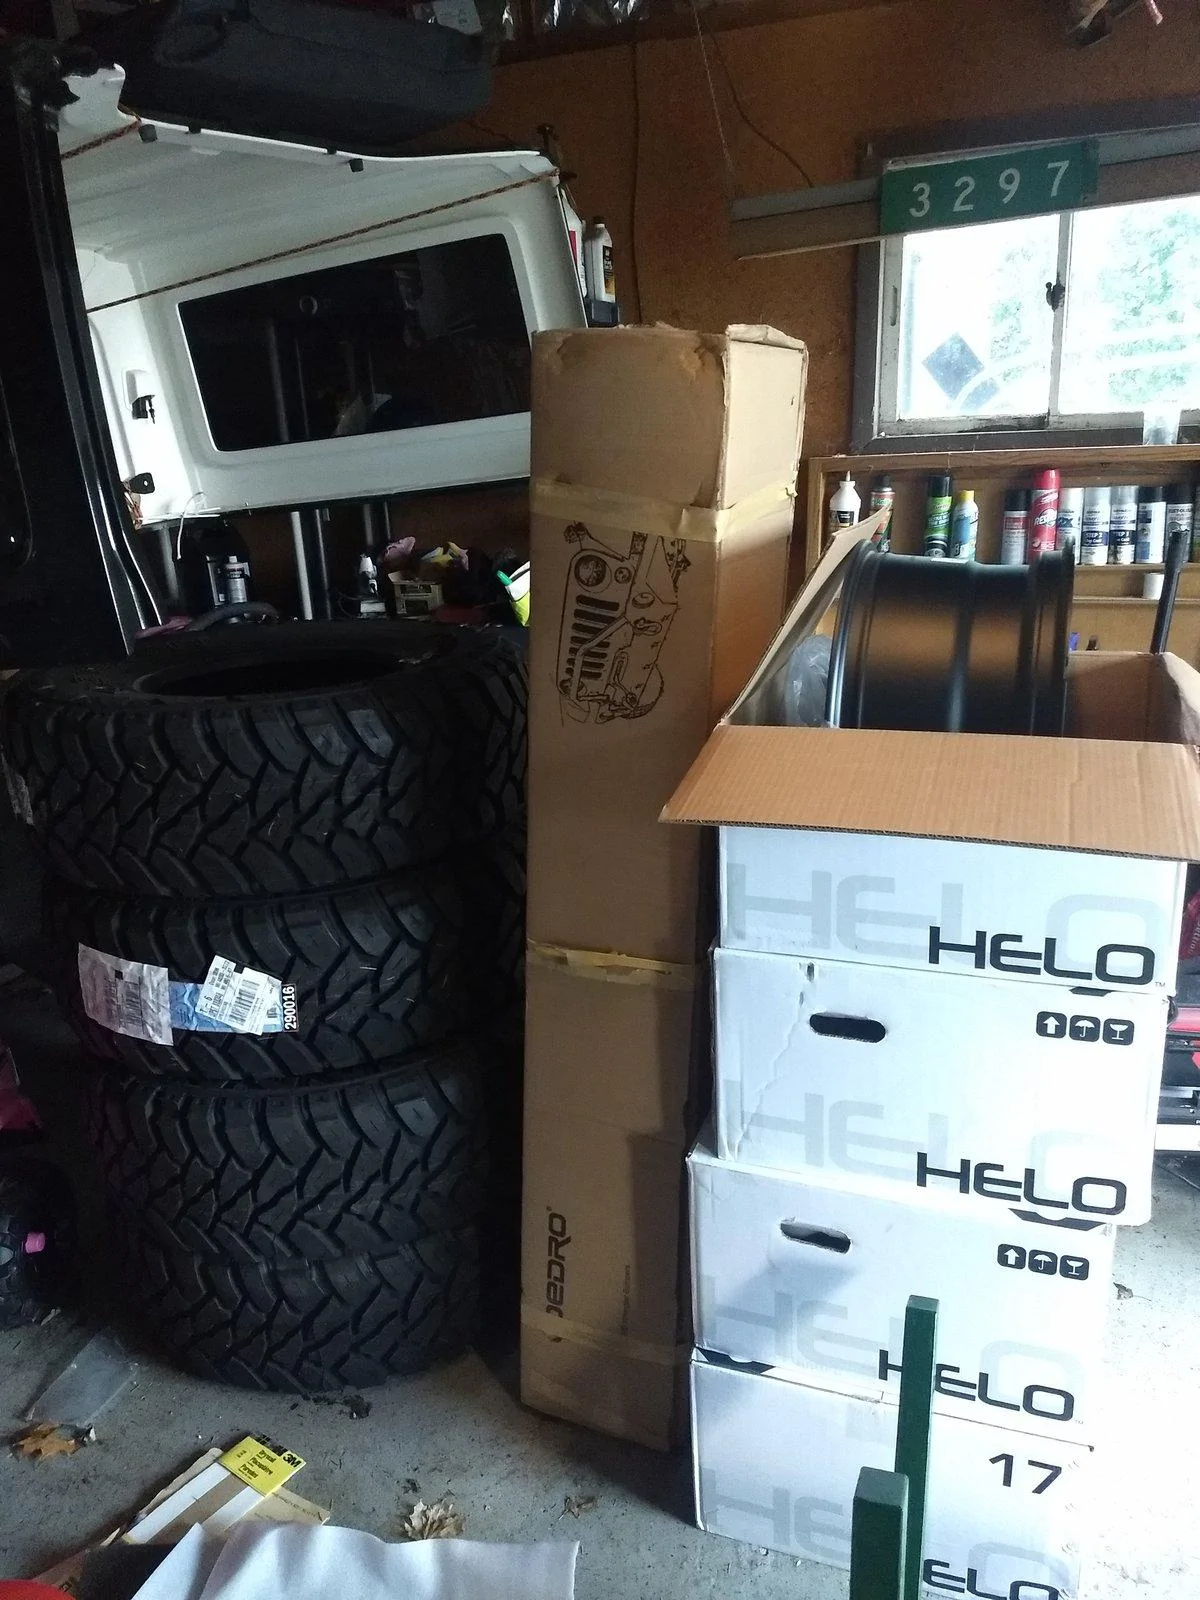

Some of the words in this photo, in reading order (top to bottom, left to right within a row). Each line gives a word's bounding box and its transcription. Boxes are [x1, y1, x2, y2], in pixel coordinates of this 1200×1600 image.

[926, 925, 1156, 986] HELO
[282, 985, 296, 1030] 290016
[915, 1150, 1128, 1218] HELO
[283, 1453, 301, 1468] 3M
[988, 1451, 1064, 1496] 17
[922, 1557, 1060, 1600] ELO
